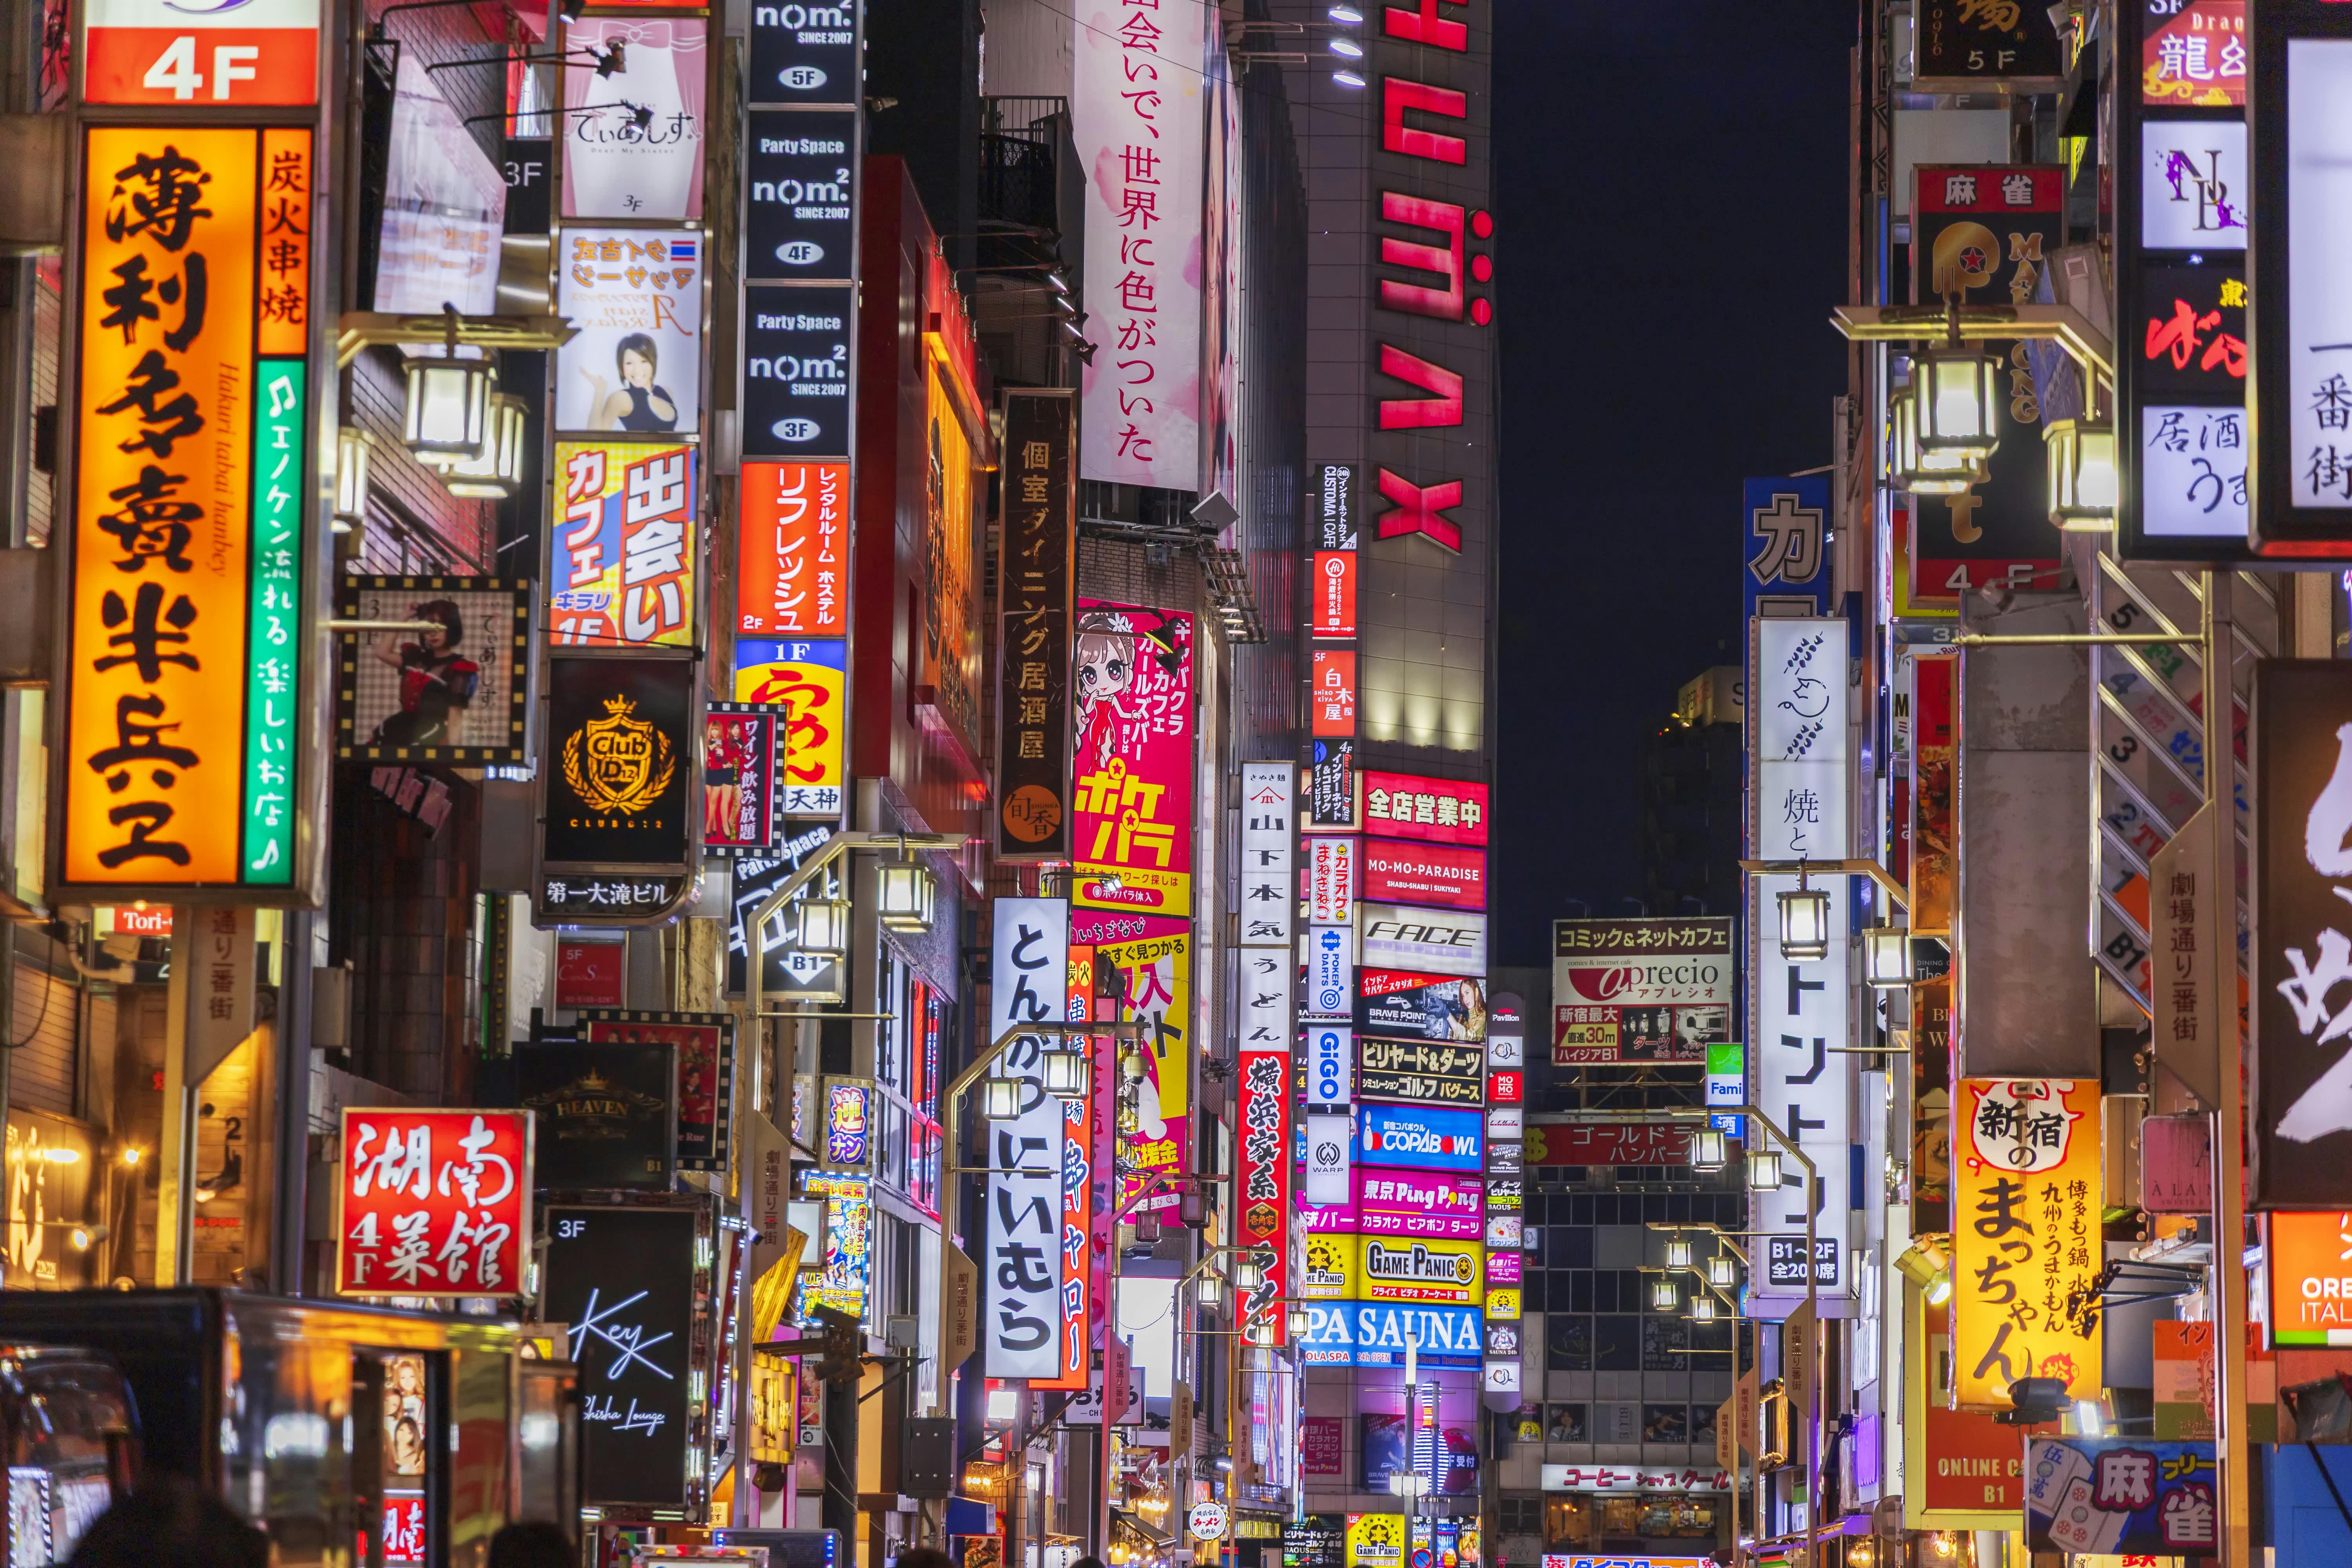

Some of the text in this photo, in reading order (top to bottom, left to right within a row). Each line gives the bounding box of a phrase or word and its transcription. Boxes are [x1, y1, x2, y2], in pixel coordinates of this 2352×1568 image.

[797, 32, 853, 44] SINCE 2007
[143, 36, 259, 100] 4F
[1967, 50, 2016, 70] 5F
[791, 71, 815, 85] 5F
[761, 138, 844, 155] Party Space
[505, 162, 543, 187] 3F
[1944, 174, 2033, 205] 麻雀
[623, 194, 643, 212] 3F
[795, 207, 849, 219] SINCE 2007
[788, 246, 811, 261] 4F
[758, 315, 841, 332] Party Space
[791, 384, 846, 396] SINCE 2007
[784, 423, 808, 437] 3F
[206, 362, 240, 578] Hakuri tabai hanbey
[565, 450, 606, 588] カフェ
[1324, 466, 1337, 548] CUSTOMA CAFE
[1338, 479, 1348, 542] インターネットカフェ
[622, 451, 687, 643] 出会い
[774, 468, 806, 631] リフレッシュ
[817, 467, 836, 624] レンタルルーム ホステル
[1945, 564, 2034, 590] 4F
[555, 592, 612, 611] キラリ
[1019, 440, 1050, 760] 個室ダイニング居酒屋
[743, 615, 763, 629] 2F
[2110, 603, 2140, 628] 5
[558, 618, 604, 645] 1F
[775, 644, 810, 661] 1F
[1314, 653, 1326, 662] 5F
[591, 732, 647, 758] Club
[1339, 741, 1353, 753] 4F
[2111, 736, 2138, 763] 3
[739, 720, 759, 841] ワイン飲み放題
[1332, 753, 1342, 821] インターネット
[788, 788, 838, 813] 天神
[1367, 788, 1481, 830] 全店営業中
[1314, 842, 1332, 921] まねきねこ
[1368, 859, 1479, 881] MO-MO-PARADISE
[548, 881, 672, 907] 第一大滝ビル
[1334, 856, 1349, 910] カラオケ
[1387, 880, 1461, 894] SHABU-SHABU SUKIYAKI
[1248, 814, 1285, 1042] 山下本気うどん
[1367, 921, 1481, 947] FACE
[1560, 927, 1727, 949] コミック&ネットカフェ
[792, 956, 818, 971] B1
[2169, 871, 2198, 1042] 劇場通り一番街
[1599, 958, 1719, 997] aprecio
[1639, 987, 1715, 999] アプレシオ
[1369, 1008, 1427, 1020] BRAVE POINT
[1492, 1014, 1519, 1022] Pavilion
[1559, 1007, 1618, 1023] 新宿最大
[1559, 1047, 1617, 1061] ハイジアB1
[1633, 1035, 1670, 1050] ダーツ
[1398, 1076, 1480, 1101] ゴルフ バグース
[1711, 1082, 1742, 1094] Fami
[556, 1100, 630, 1116] HEAVEN
[1247, 1056, 1282, 1200] 横浜家系
[1718, 1116, 1736, 1134] 酒
[1977, 1098, 2065, 1149] 新宿
[828, 1134, 865, 1162] ナン
[1383, 1128, 1478, 1156] COPABOWL
[353, 1115, 514, 1208] 湖南
[646, 1160, 662, 1172] B1
[2008, 1145, 2037, 1169] の
[764, 1150, 781, 1246] 劇場通り一番街
[1364, 1180, 1394, 1200] 東京
[558, 1220, 585, 1238] 3F
[1363, 1215, 1479, 1234] カラオケ ダーツ
[2066, 1180, 2089, 1267] 博多もつ鍋
[384, 1210, 511, 1289] 菜館
[2041, 1181, 2064, 1333] 九州のうまかもん
[1973, 1177, 2038, 1385] まっちゃん
[1372, 1287, 1468, 1301] プライズ ビデオ アーケード 音楽
[955, 1271, 969, 1347] 劇場通り一番街
[567, 1289, 673, 1379] Key
[1358, 1307, 1481, 1350] SAUNA
[1329, 1352, 1350, 1361] SPA
[1357, 1352, 1390, 1362] 24h OPEN
[1420, 1354, 1477, 1366] Room Restaurant
[1115, 1352, 1125, 1406] 劇場通り一番街
[1563, 1468, 1631, 1488] コーヒー
[1938, 1457, 2000, 1477] ONLINE
[1984, 1485, 2004, 1503] B1
